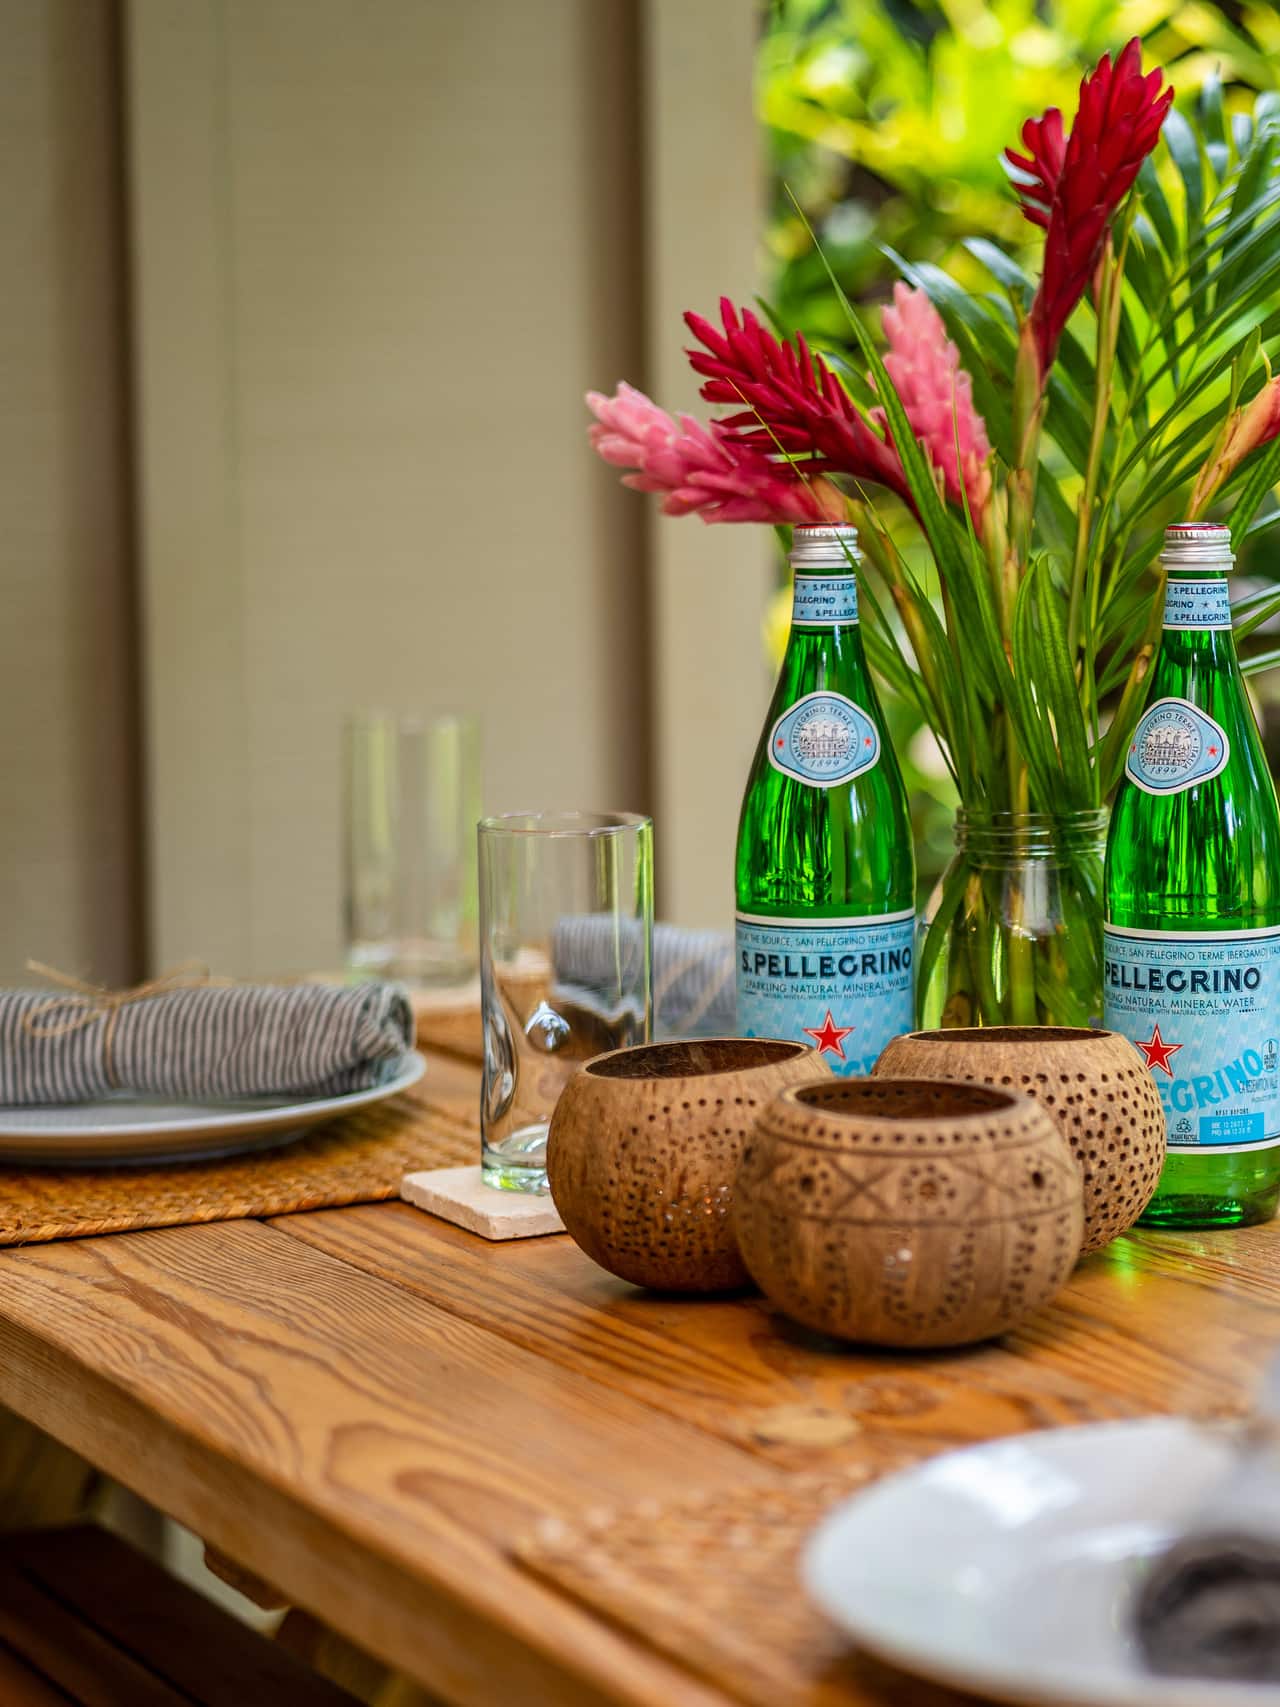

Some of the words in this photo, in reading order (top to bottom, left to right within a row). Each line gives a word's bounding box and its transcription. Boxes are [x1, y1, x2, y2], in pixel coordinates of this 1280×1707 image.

[810, 759, 840, 768] 1899
[796, 937, 813, 946] SAN
[816, 936, 866, 946] PELLEGRINO
[868, 933, 888, 944] TERME
[1129, 948, 1144, 958] SAN
[1146, 949, 1195, 961] PELLEGRINO
[1198, 951, 1225, 960] TERME
[741, 947, 912, 978] S.PELLEGRINO
[791, 983, 839, 994] NATURAL
[842, 981, 885, 993] MINERAL
[1125, 995, 1167, 1009] NATURAL
[1170, 998, 1219, 1009] MINERAL
[1222, 996, 1256, 1008] WATER
